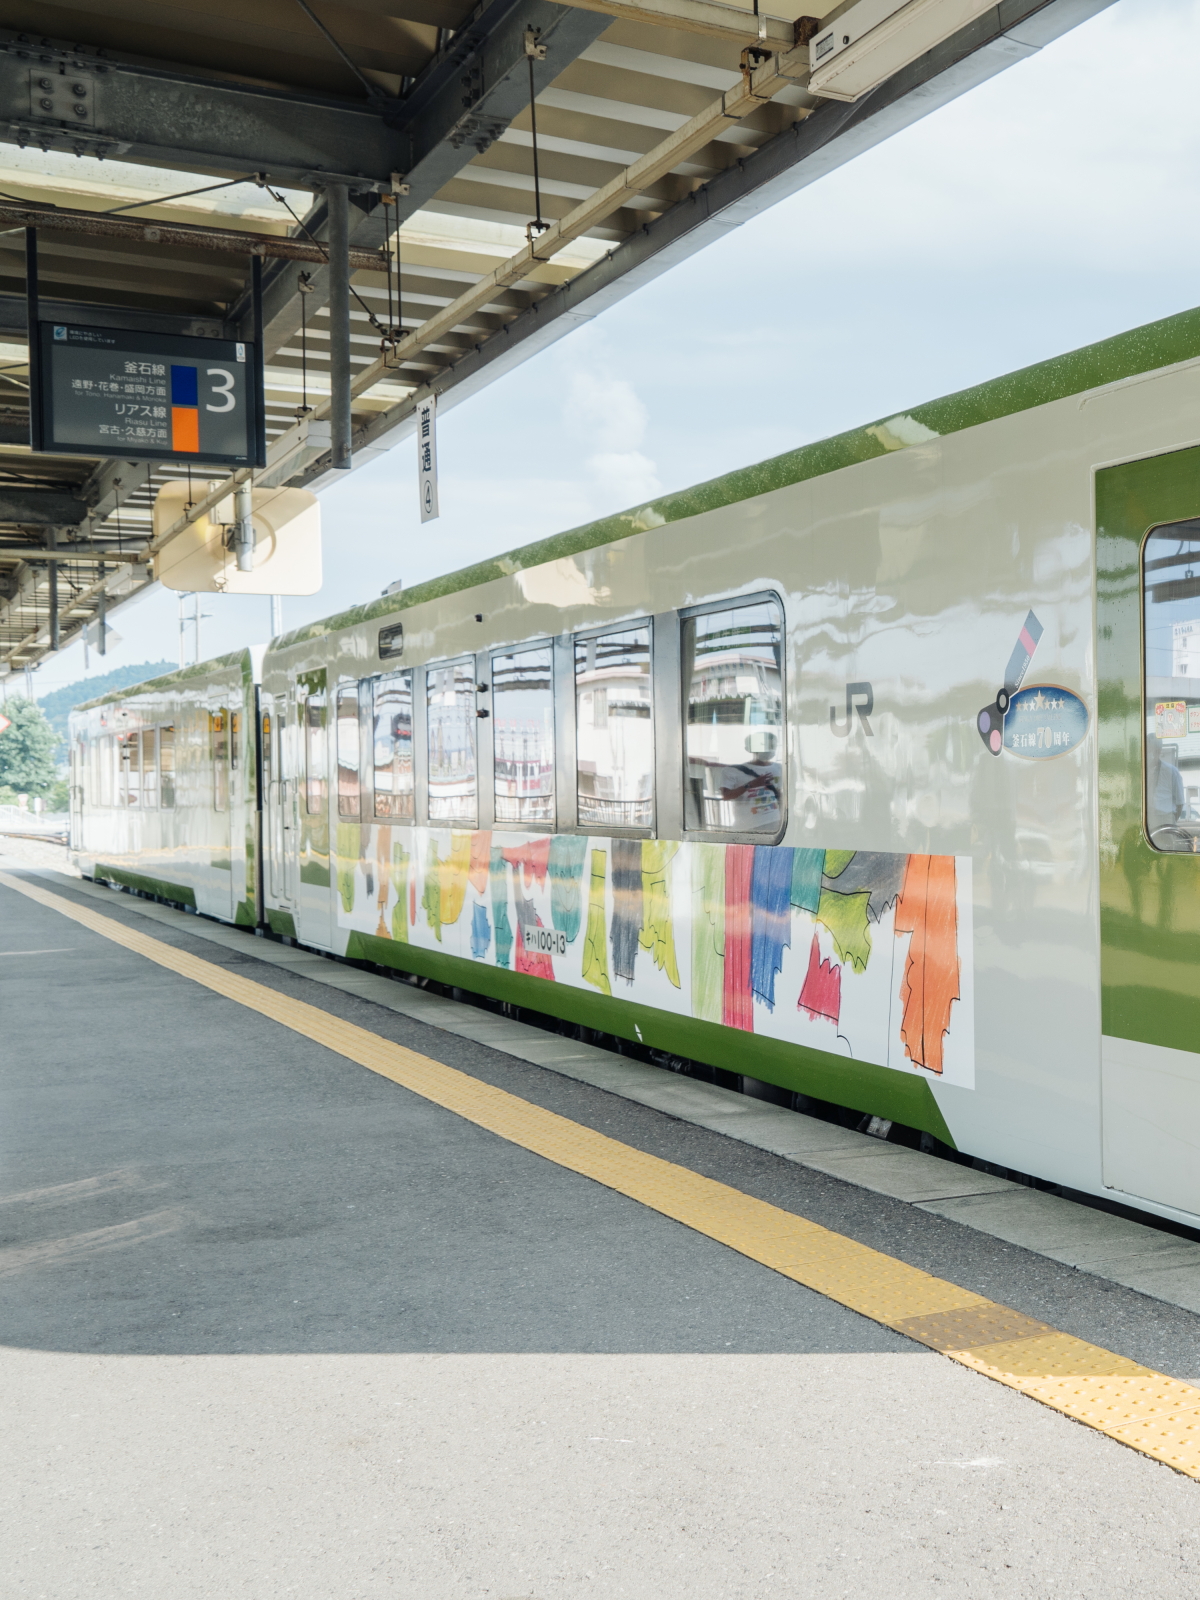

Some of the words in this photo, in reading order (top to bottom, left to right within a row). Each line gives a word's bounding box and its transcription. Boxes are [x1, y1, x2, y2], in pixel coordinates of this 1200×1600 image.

[124, 361, 166, 376] 釜石線
[109, 373, 147, 383] Kamaishi
[149, 377, 167, 385] Line
[206, 368, 236, 413] 3
[114, 403, 167, 418] リアス線
[124, 417, 148, 426] Riasu
[150, 419, 167, 427] Line
[830, 681, 875, 738] JR
[526, 931, 566, 954] キハ100-13
